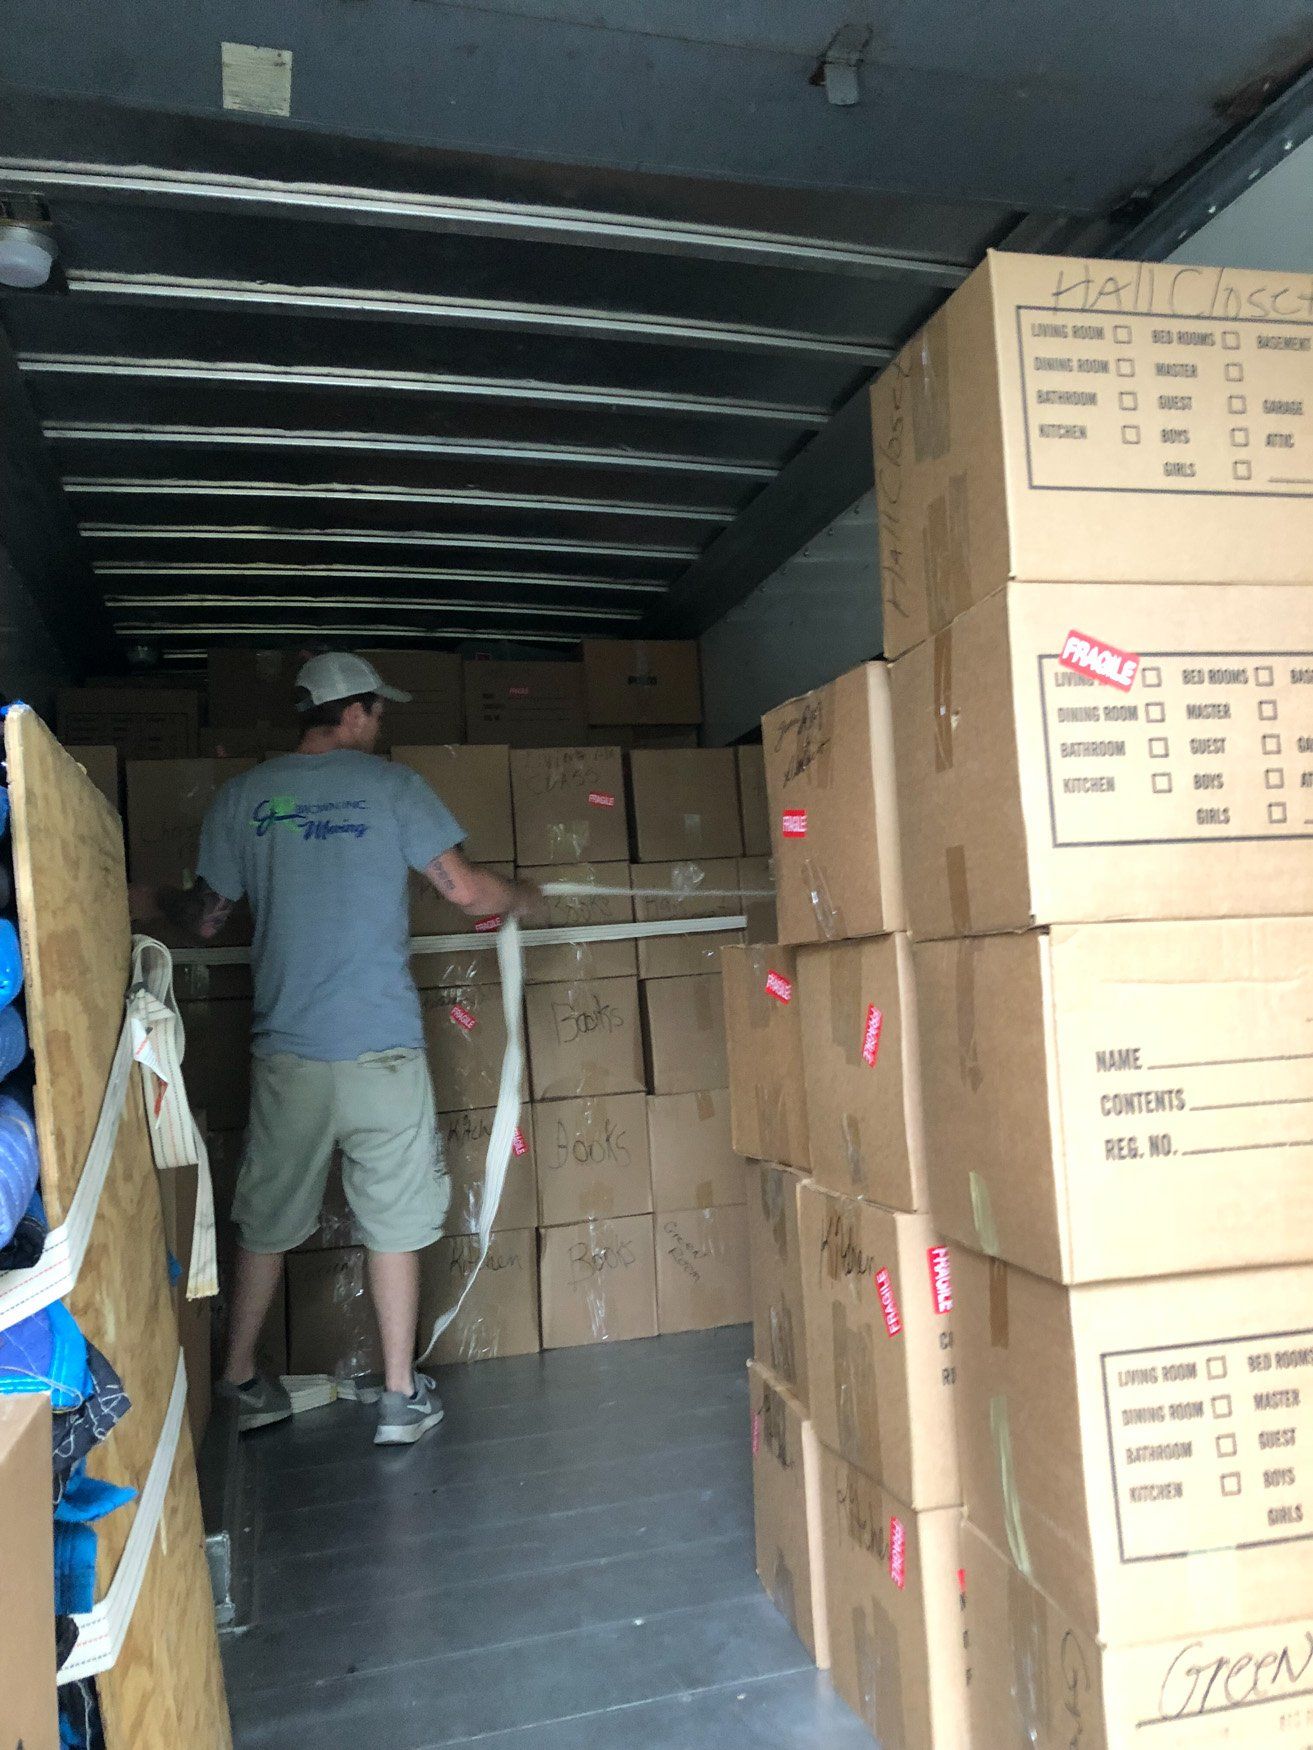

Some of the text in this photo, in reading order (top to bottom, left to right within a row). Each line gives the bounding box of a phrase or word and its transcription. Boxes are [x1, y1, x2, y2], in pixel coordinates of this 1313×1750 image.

[1031, 323, 1105, 340] LIVING ROOM
[1152, 329, 1216, 347] BED ROOMS
[1034, 356, 1110, 374] DINING ROOM
[1155, 362, 1198, 378] MASTER
[1036, 390, 1098, 406] BATHROOM
[1158, 394, 1193, 411] GUEST
[1039, 423, 1088, 440] KITCHEN
[1161, 428, 1190, 444] BOYS
[1163, 461, 1197, 478] GIRLS
[1062, 637, 1137, 686] FRAGILE
[1182, 667, 1249, 685] BED ROOMS
[1057, 705, 1139, 723] DINING ROOM
[1186, 702, 1231, 720] MASTER
[1060, 740, 1126, 758] BATHROOM
[1189, 737, 1226, 755] GUEST
[1063, 776, 1115, 794] KITCHEN
[1193, 772, 1224, 790] BOYS
[1196, 807, 1231, 825] GIRLS
[1095, 1047, 1143, 1073] NAME
[1100, 1088, 1186, 1117] CONTENTS
[1104, 1133, 1178, 1161] REG. NO.
[932, 1247, 954, 1313] FRAGILE
[876, 1270, 901, 1335] FRAGILE
[1247, 1352, 1272, 1373] BED
[1118, 1362, 1197, 1387] LIVING ROOM
[1253, 1388, 1300, 1411] MASTER
[1122, 1401, 1204, 1426] DINING ROOM
[1258, 1427, 1297, 1450] GUEST
[1126, 1440, 1193, 1465] BATHROOM
[1263, 1467, 1296, 1489] BOYS
[1129, 1481, 1184, 1503] KITCHEN
[1267, 1504, 1304, 1527] GIRLS
